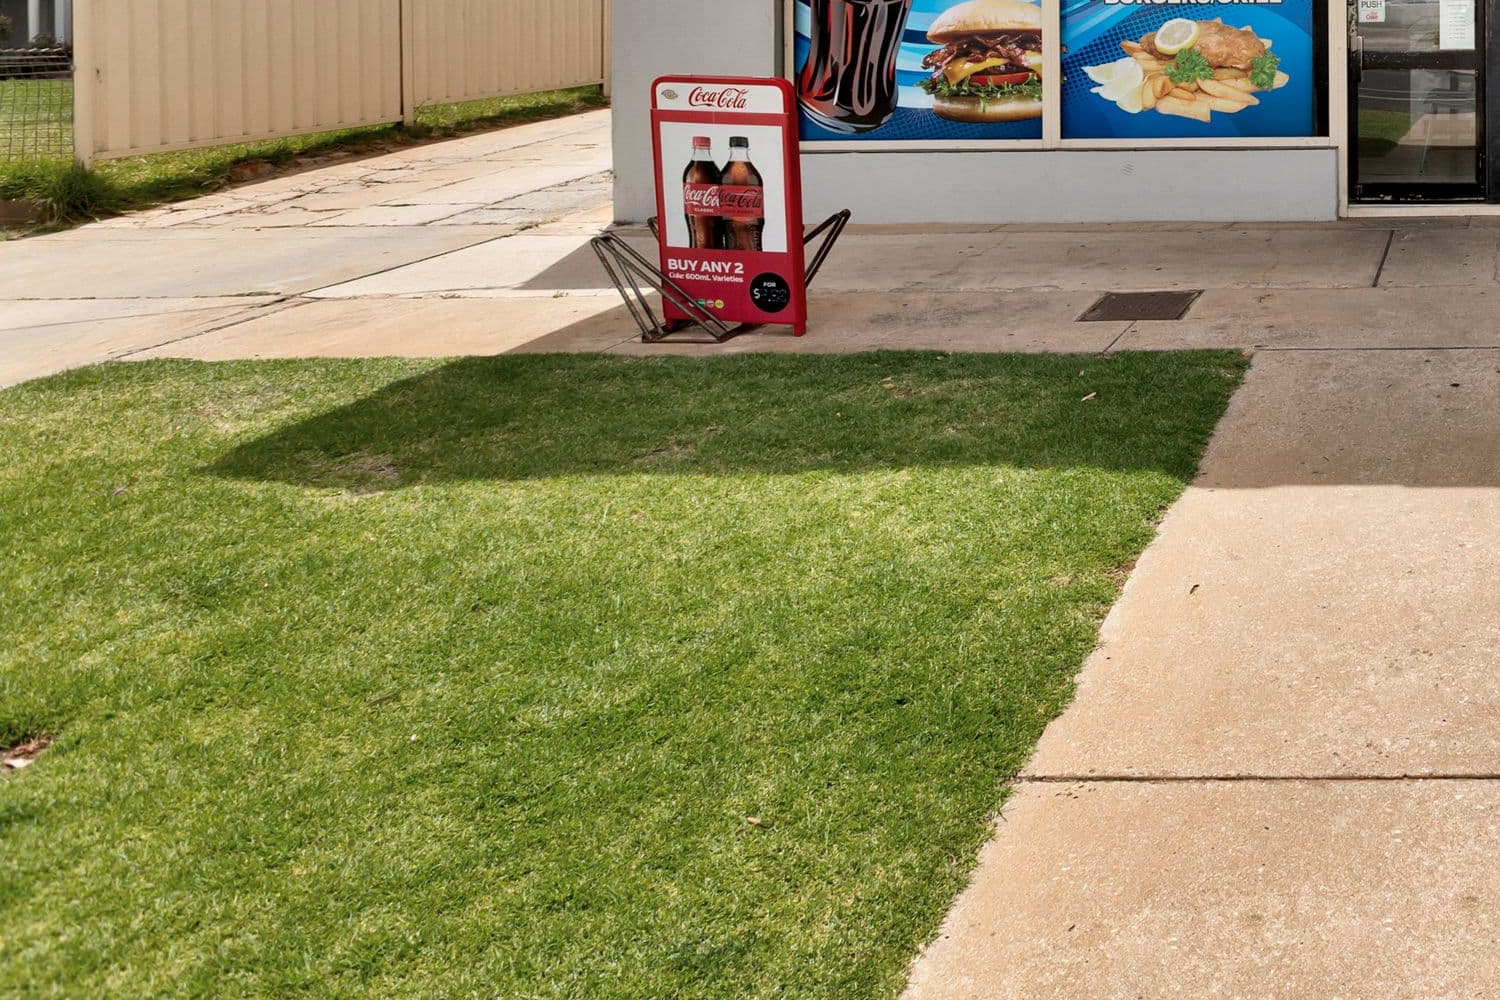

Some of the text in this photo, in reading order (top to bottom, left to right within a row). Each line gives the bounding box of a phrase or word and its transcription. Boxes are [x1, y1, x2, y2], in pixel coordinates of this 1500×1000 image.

[688, 86, 749, 109] Coca-Cola
[668, 259, 744, 274] BUY ANY 2
[685, 273, 711, 281] 600mL
[712, 275, 744, 283] Varieties
